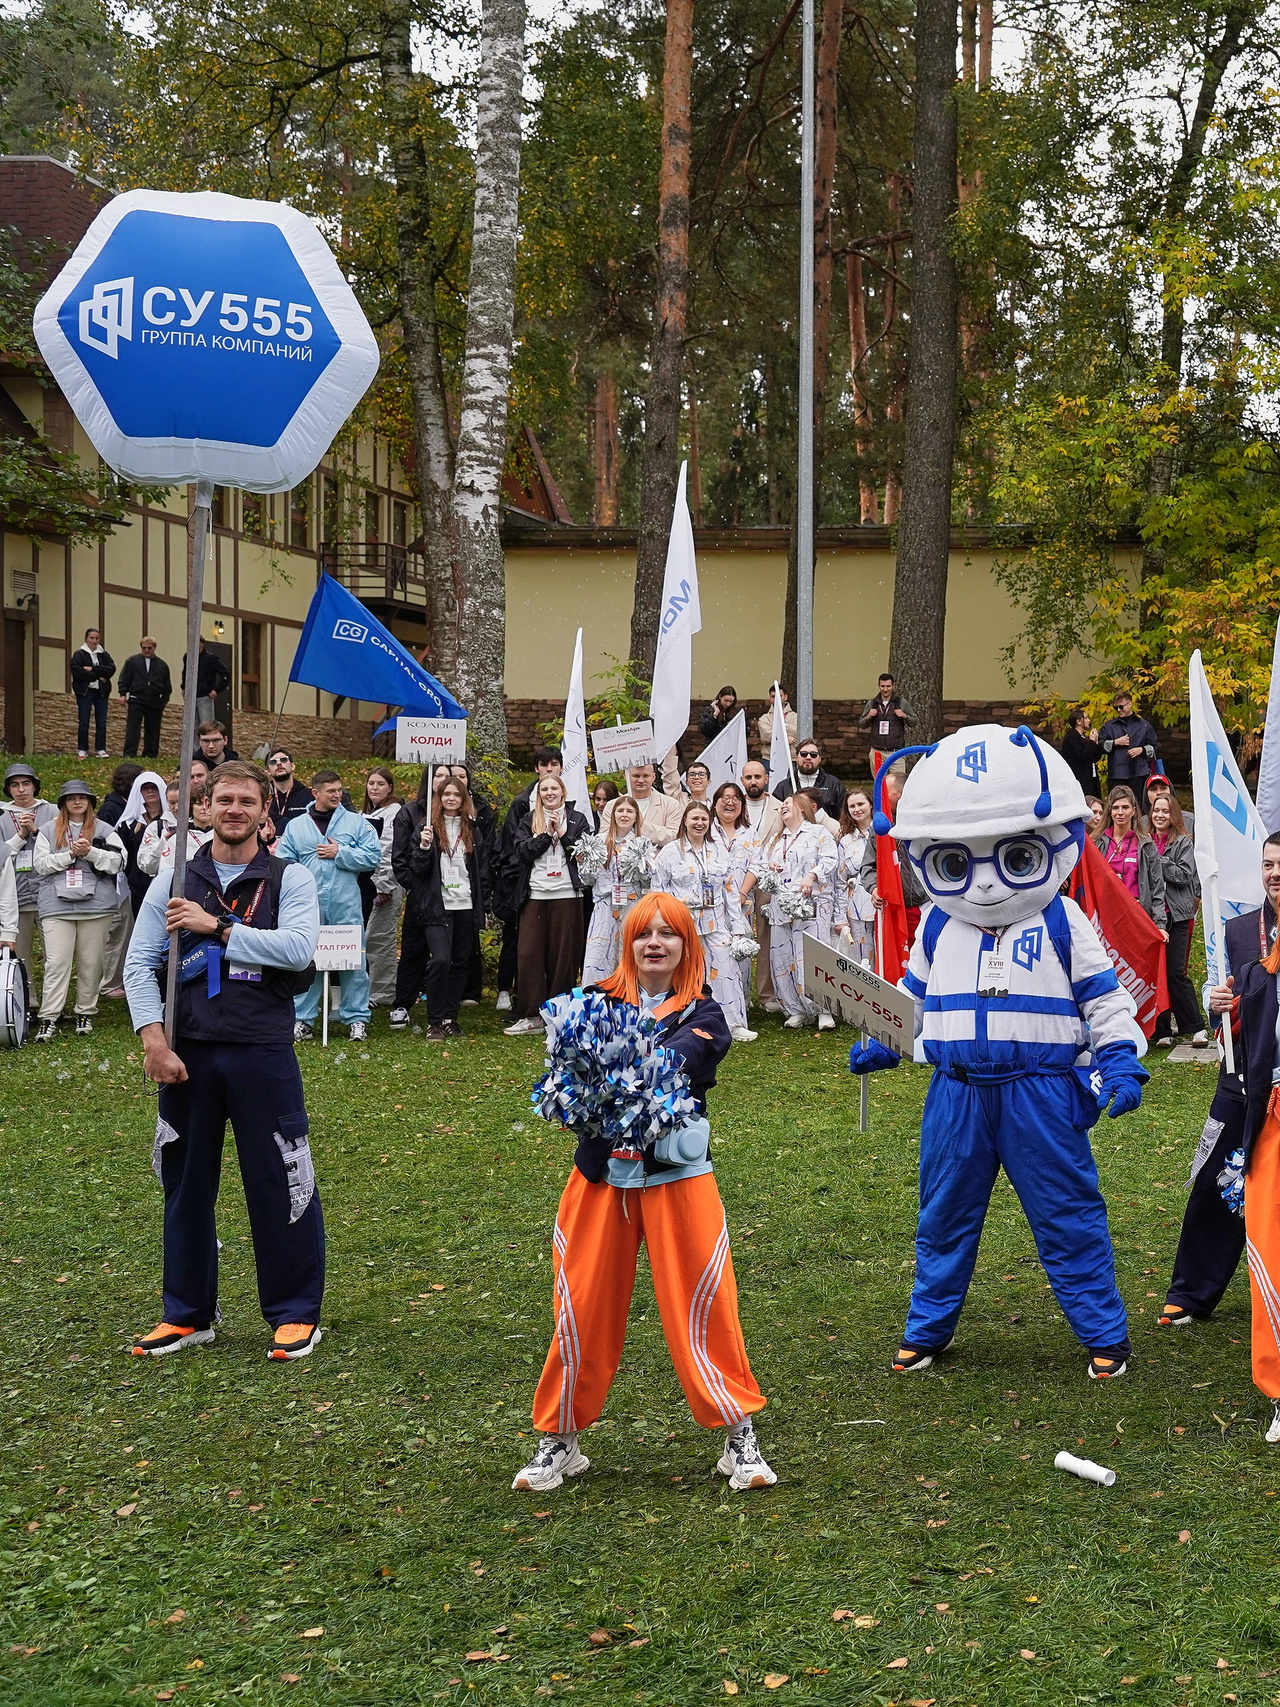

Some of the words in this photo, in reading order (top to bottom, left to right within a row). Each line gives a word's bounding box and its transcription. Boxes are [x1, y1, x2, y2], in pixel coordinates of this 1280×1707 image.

[141, 330, 207, 348] ГРУППА
[212, 335, 313, 362] КОМПАНИЙ
[339, 624, 362, 638] CG
[370, 636, 417, 682] CAPITAL
[407, 721, 457, 730] КОЛДИ
[410, 736, 452, 746] КОЛДИ
[814, 965, 837, 989] ГК
[840, 982, 903, 1029] СУ-555
